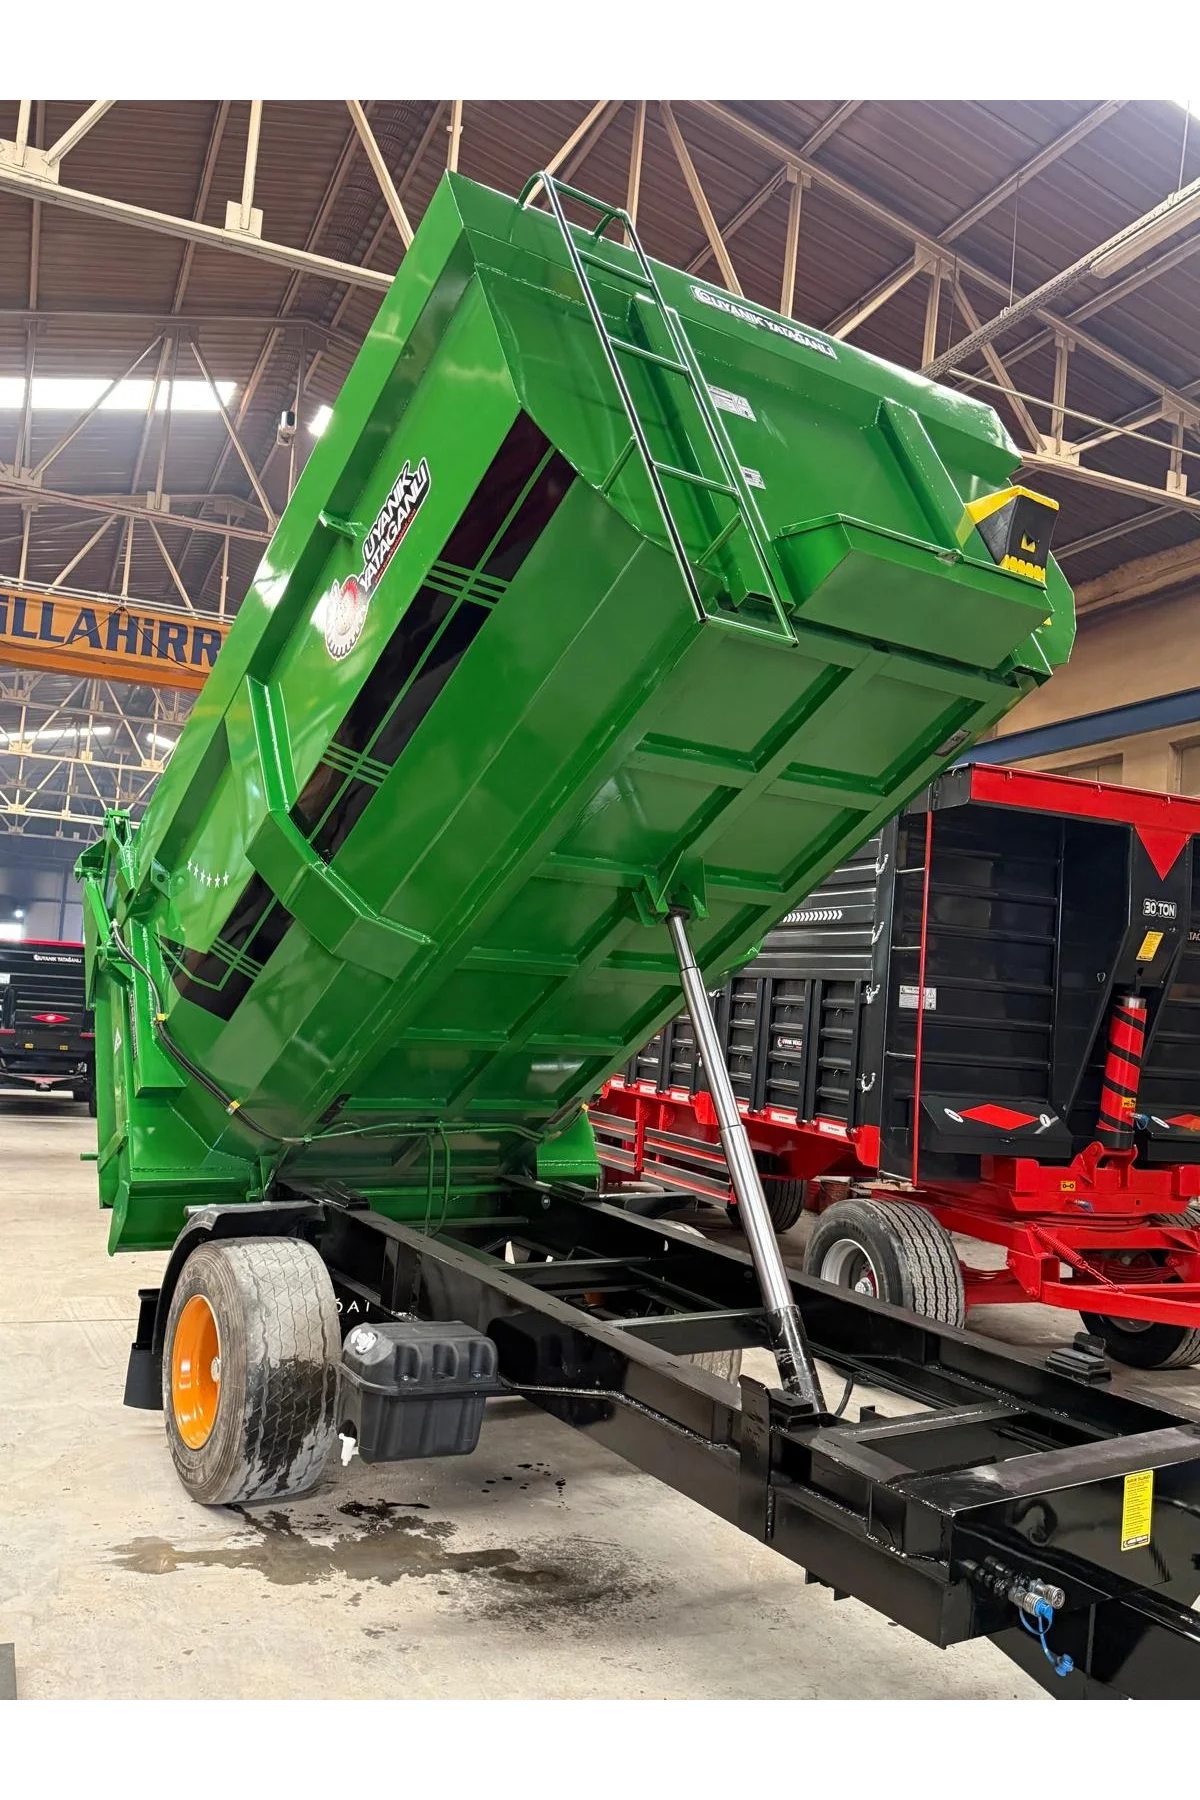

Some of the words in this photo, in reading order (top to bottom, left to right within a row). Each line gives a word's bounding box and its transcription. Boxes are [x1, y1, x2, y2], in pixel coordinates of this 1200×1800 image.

[710, 297, 767, 329] UYANIK
[364, 465, 412, 561] UYANIK
[1144, 901, 1157, 915] 30
[1158, 902, 1176, 917] TON
